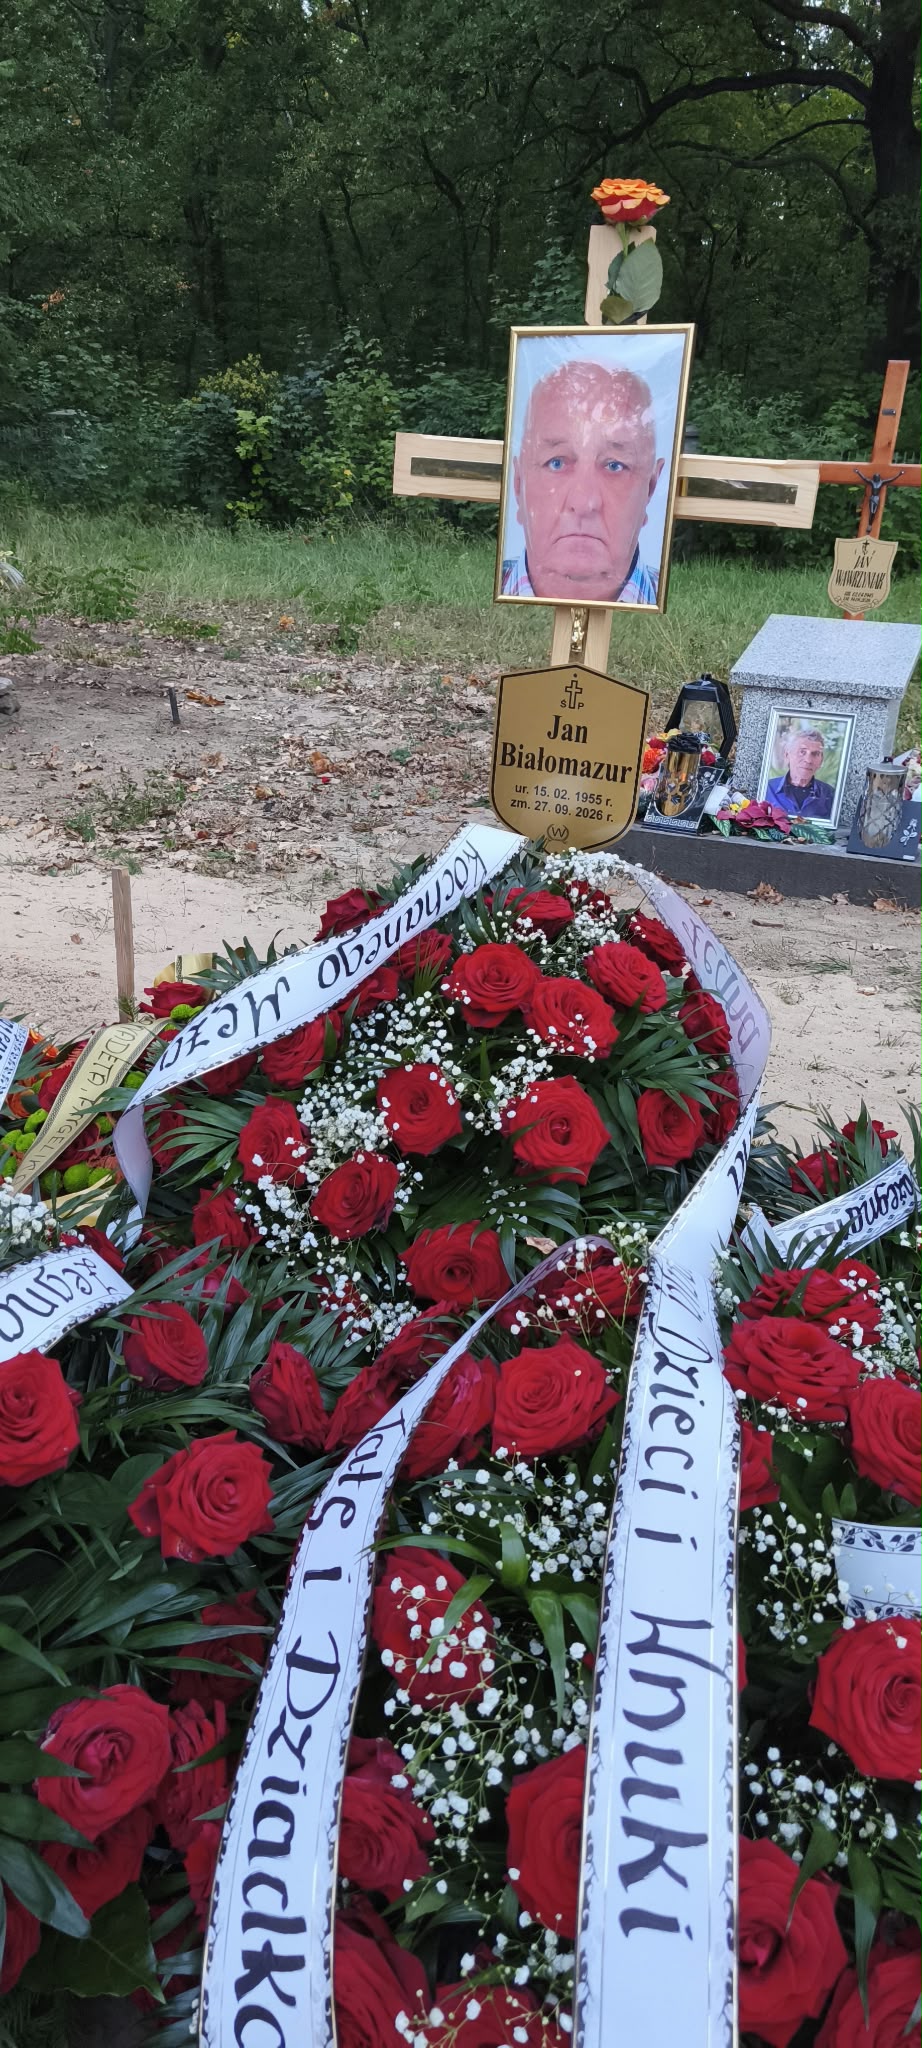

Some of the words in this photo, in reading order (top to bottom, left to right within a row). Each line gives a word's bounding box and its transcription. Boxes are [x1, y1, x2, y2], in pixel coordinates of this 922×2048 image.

[547, 715, 588, 744] Jan
[499, 741, 633, 784] Białomazur
[510, 798, 530, 810] zm.
[535, 800, 551, 813] 27.
[555, 803, 571, 816] 09.
[575, 806, 603, 821] 2026
[606, 811, 614, 823] r.
[515, 785, 529, 794] ur.
[534, 785, 550, 798] 15.
[554, 788, 570, 800] 02.
[576, 791, 602, 805] 1955
[605, 797, 613, 808] r.
[317, 839, 489, 989] Kochanego
[638, 1311, 714, 1500] Dzieci
[635, 1526, 697, 1552] i
[303, 1565, 351, 1588] i
[618, 1608, 728, 1942] Wnuki
